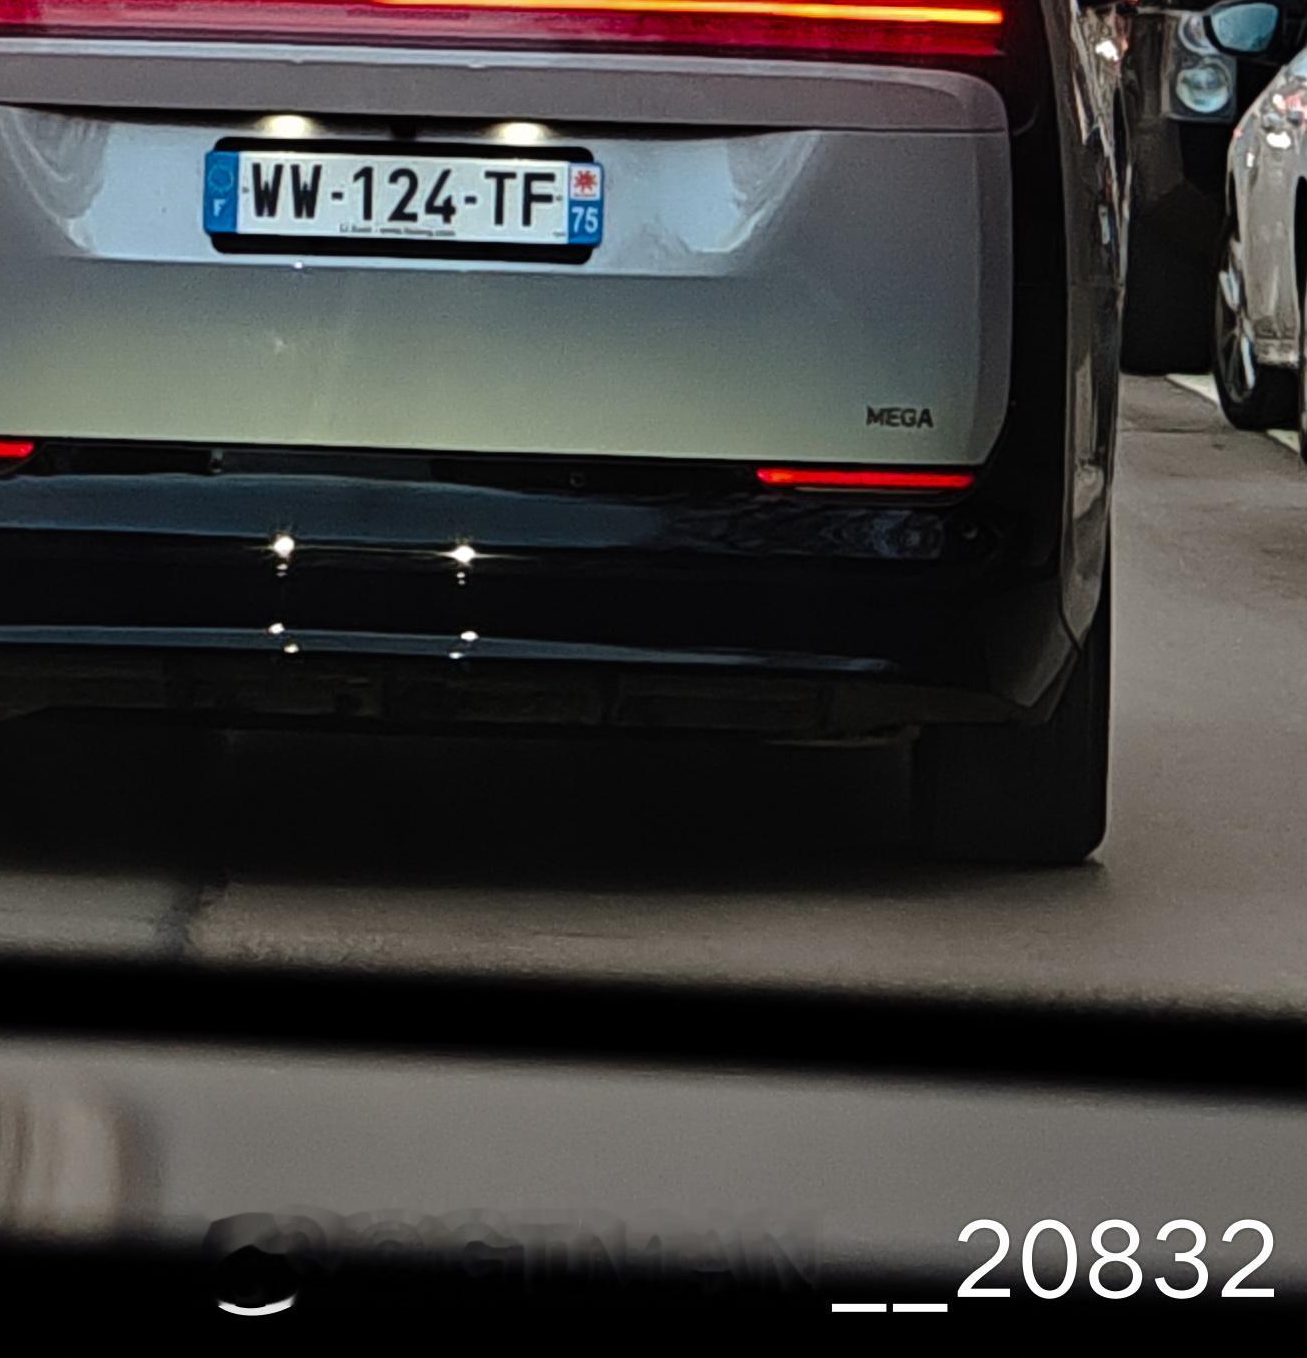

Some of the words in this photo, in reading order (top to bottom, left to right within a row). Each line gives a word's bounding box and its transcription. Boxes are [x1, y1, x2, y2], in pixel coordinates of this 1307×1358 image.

[251, 162, 557, 227] WW-124-TF
[212, 198, 227, 218] F
[571, 205, 599, 234] 75
[865, 405, 934, 428] MEGA
